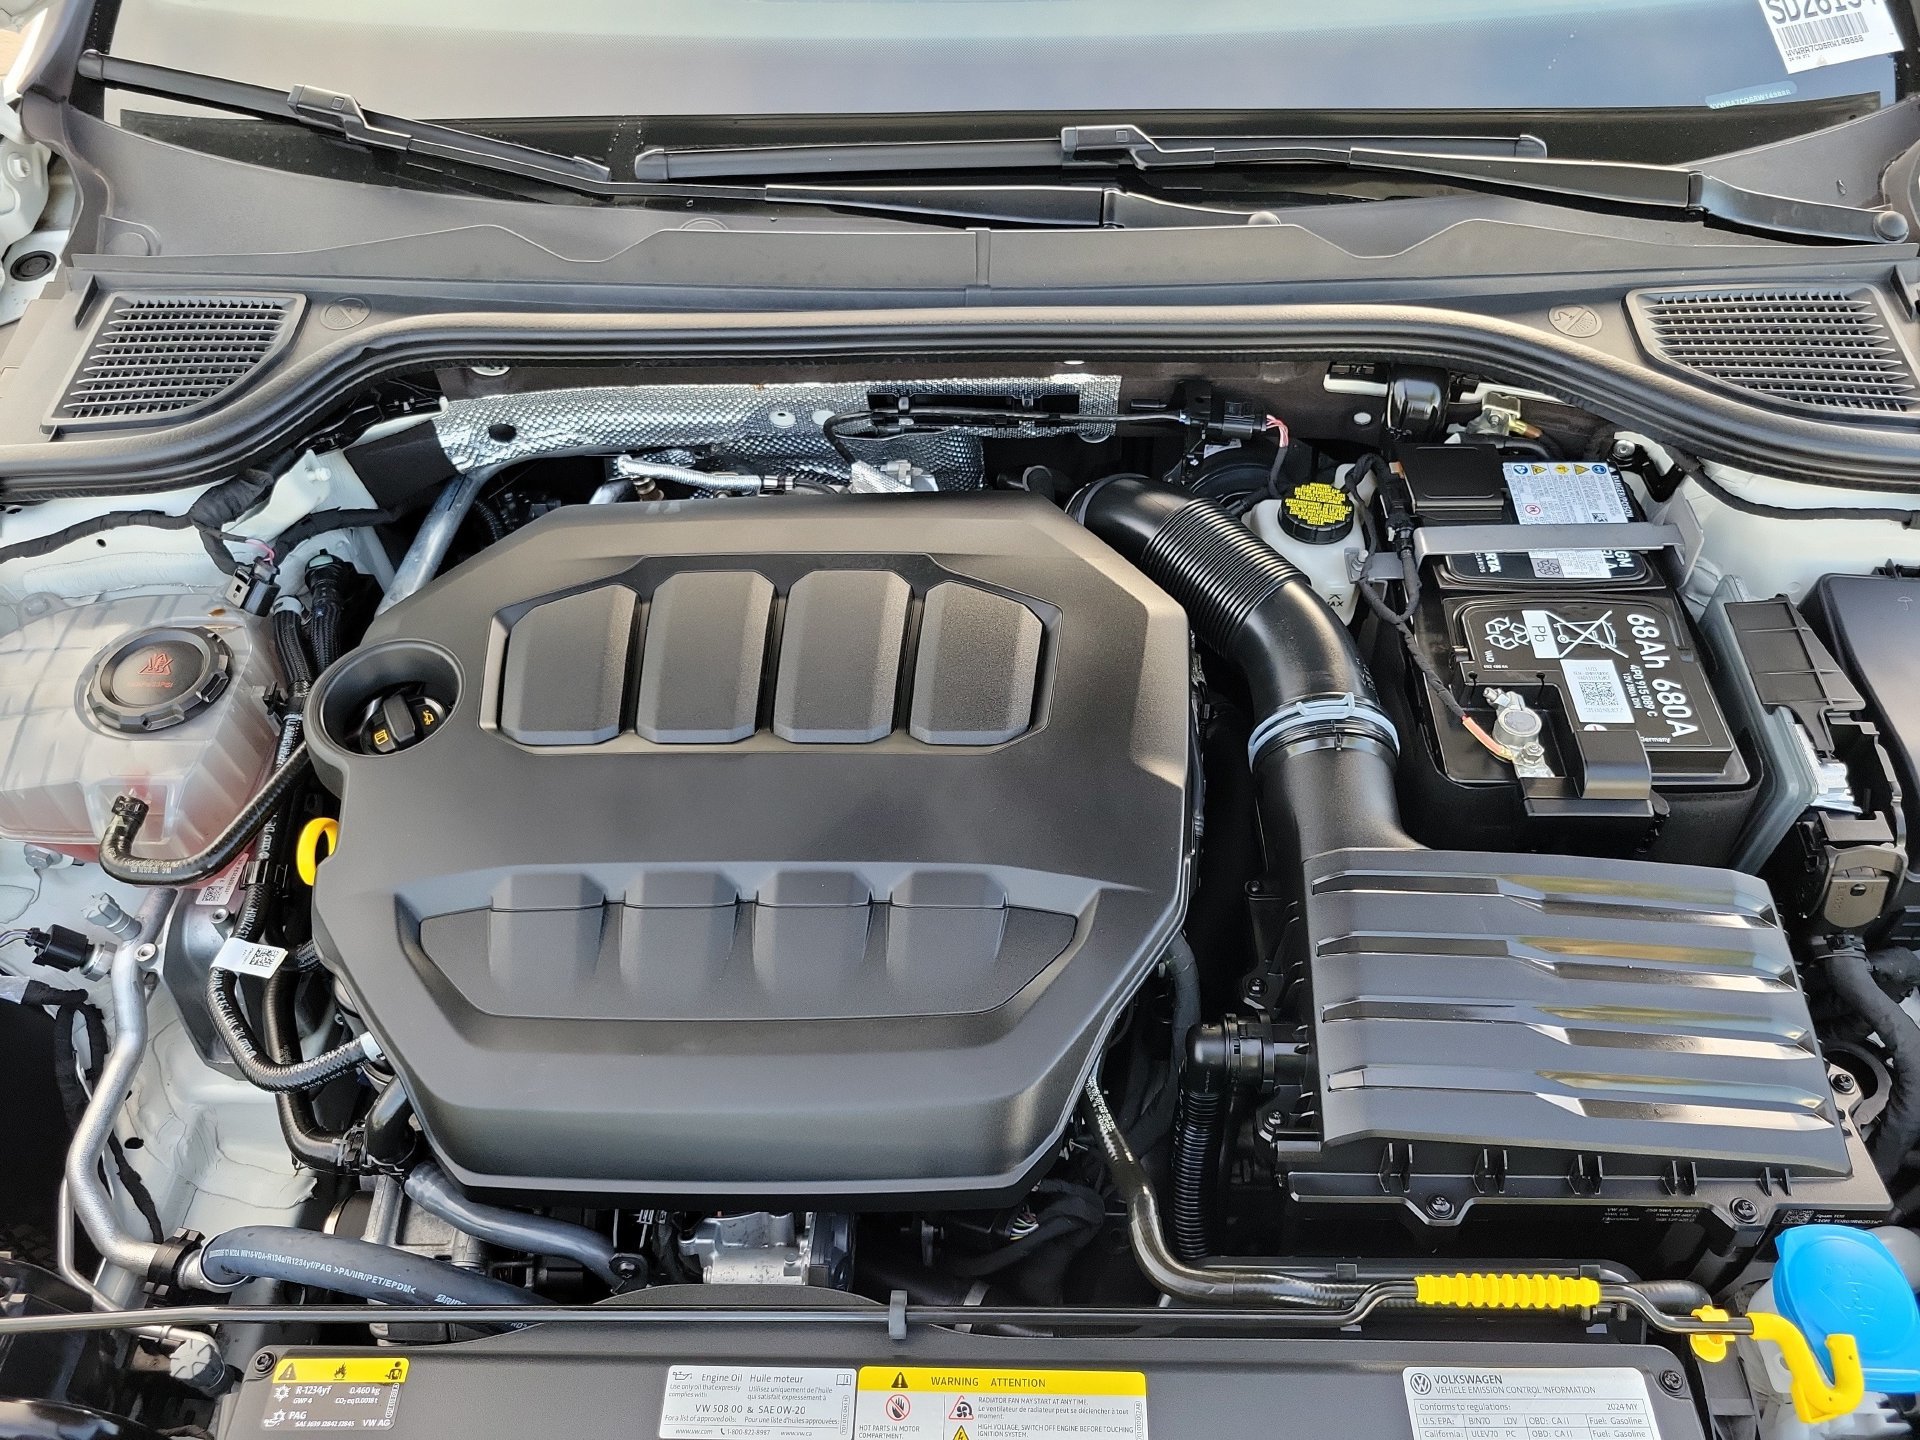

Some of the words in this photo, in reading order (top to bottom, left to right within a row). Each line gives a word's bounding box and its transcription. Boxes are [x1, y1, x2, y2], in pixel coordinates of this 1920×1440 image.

[1485, 552, 1501, 573] RTA
[1614, 550, 1635, 568] GM
[1532, 625, 1548, 643] Pb
[1626, 613, 1671, 669] 68Ah
[1651, 678, 1699, 738] 680A
[701, 1373, 729, 1383] Engine
[731, 1373, 743, 1382] Oil
[749, 1374, 772, 1383] Huile
[930, 1376, 979, 1387] WARNING
[990, 1377, 1046, 1388] ATTENTION
[1433, 1374, 1503, 1384] VOLKSWAGEN
[1435, 1386, 1467, 1394] VEHICLE
[1467, 1386, 1505, 1394] EMISSION
[1505, 1386, 1542, 1394] CONTROL
[1542, 1386, 1596, 1394] INFORMATION
[978, 1396, 1007, 1404] RADIATOR
[695, 1404, 711, 1413] VW
[712, 1404, 729, 1413] 508
[731, 1405, 743, 1413] 00
[758, 1405, 774, 1414] SAE
[776, 1405, 806, 1414] 0W-20
[1055, 1407, 1070, 1415] peut
[1419, 1403, 1456, 1411] Conforms
[1456, 1403, 1465, 1411] to
[1466, 1403, 1511, 1412] regulations:
[1607, 1403, 1625, 1411] 2024
[1625, 1403, 1638, 1411] MY
[1503, 1417, 1518, 1425] LDV
[1528, 1417, 1548, 1425] OBD:
[1589, 1417, 1607, 1425] Fuel:
[1610, 1416, 1642, 1425] Gasoline
[1424, 1430, 1464, 1438] California:
[1505, 1430, 1516, 1438] PC
[1531, 1430, 1552, 1438] OBD:
[1592, 1430, 1611, 1438] Fuel:
[1613, 1430, 1646, 1438] Gasoline
